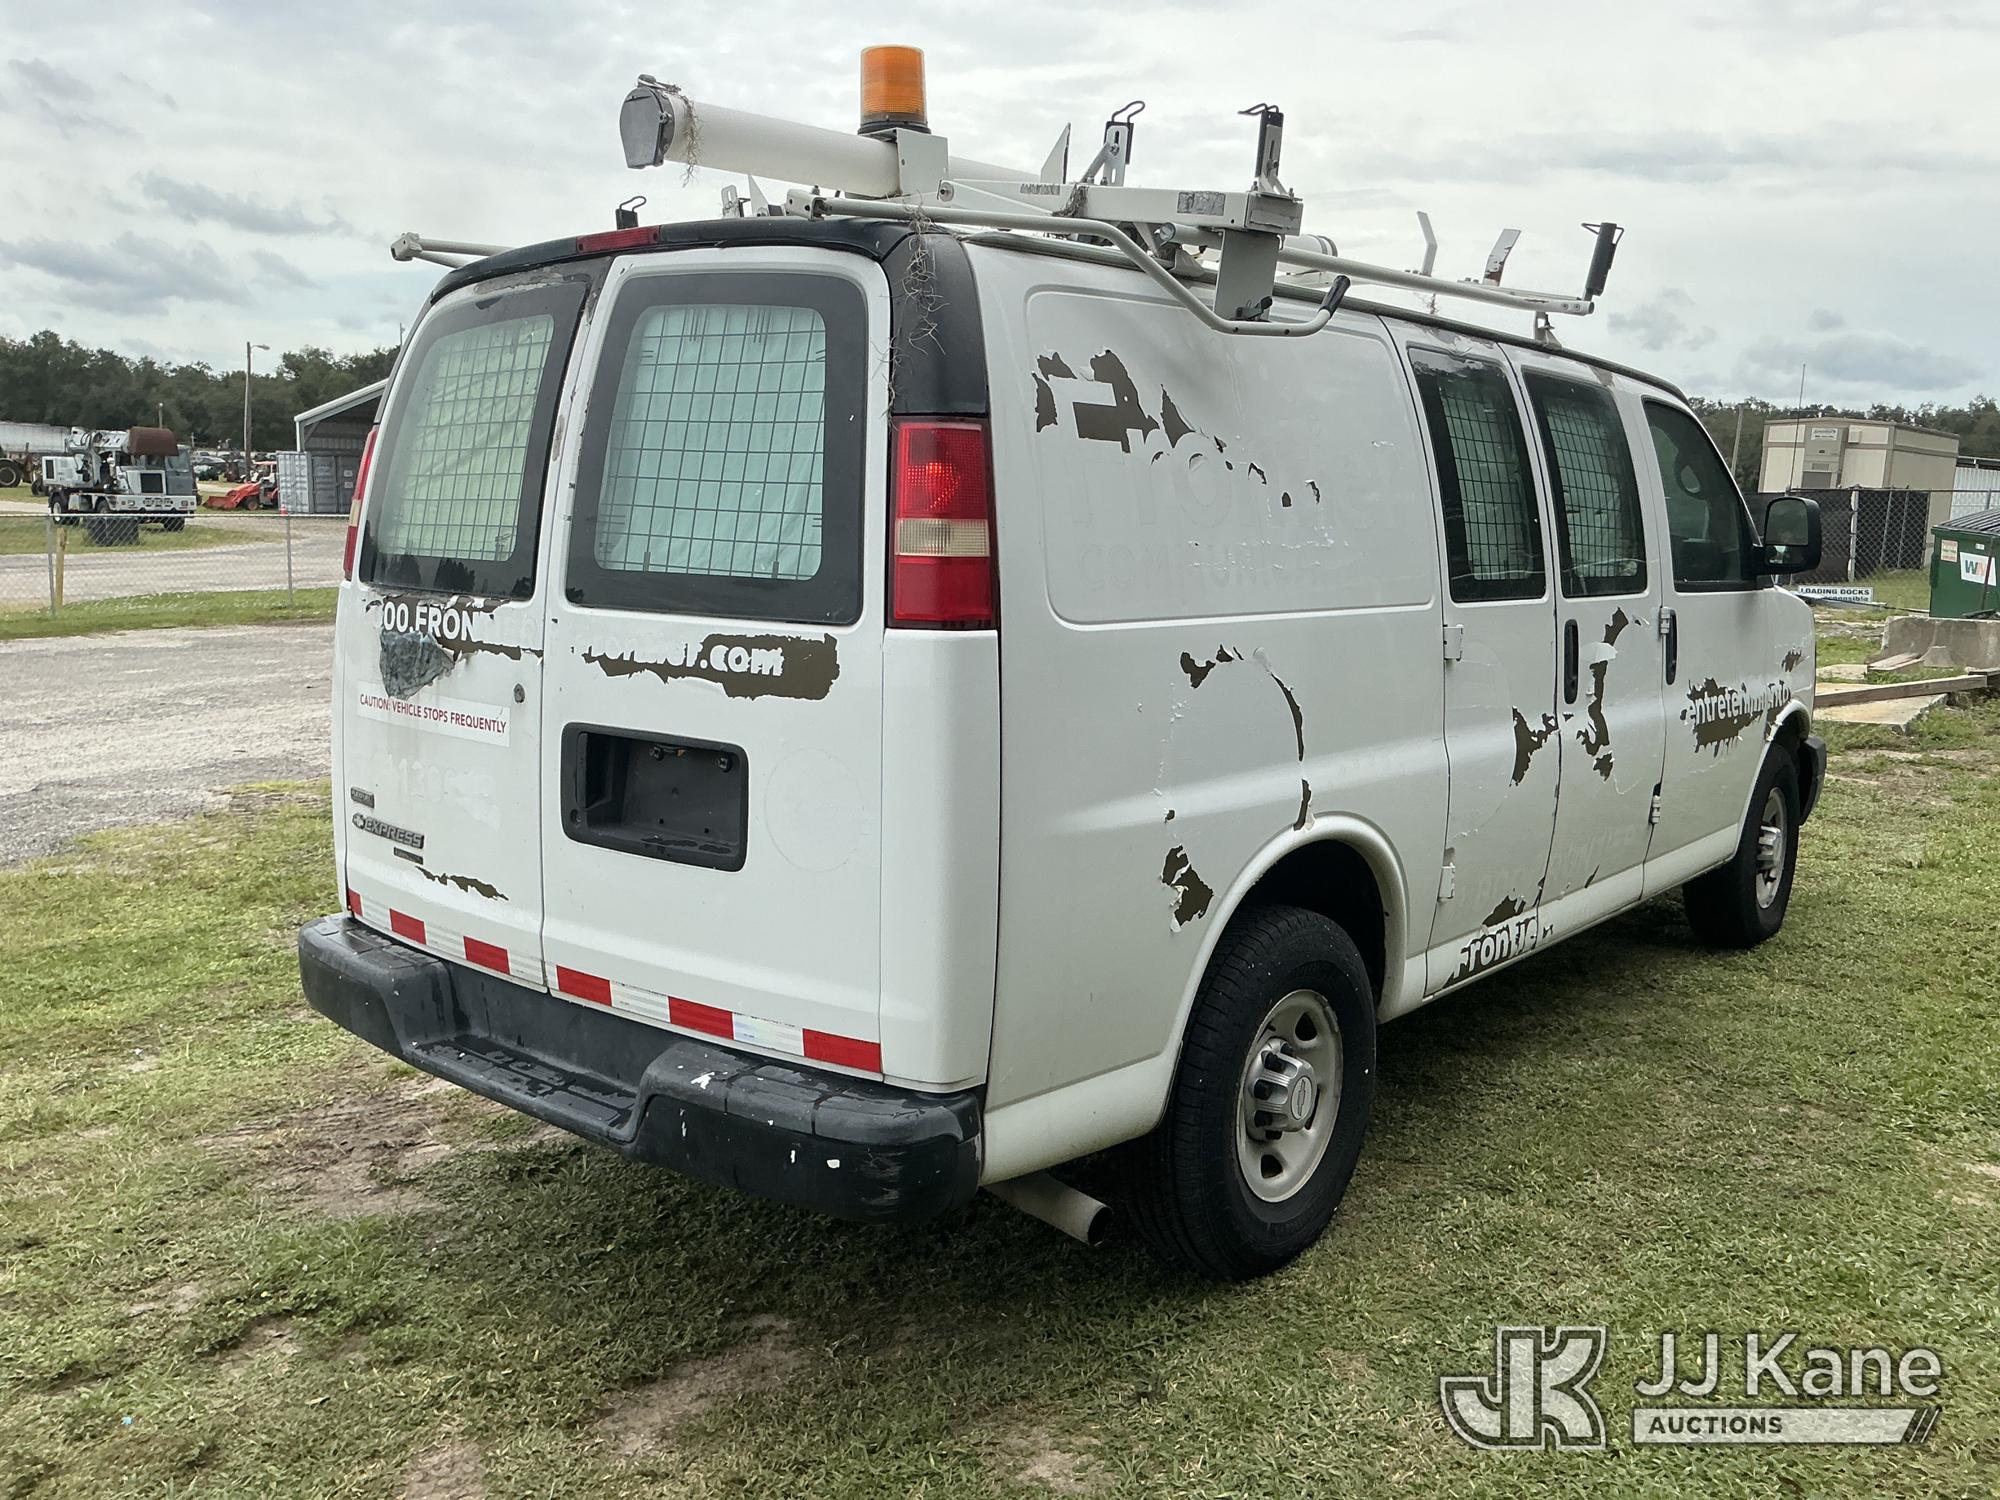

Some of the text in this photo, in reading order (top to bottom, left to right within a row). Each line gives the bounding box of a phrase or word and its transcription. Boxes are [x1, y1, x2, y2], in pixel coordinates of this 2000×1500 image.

[1800, 587, 1838, 595] LOADING
[360, 694, 507, 734] CAUTION: VEHICLE STOPS FREQUENTLY
[364, 818, 424, 849] EXPRESS
